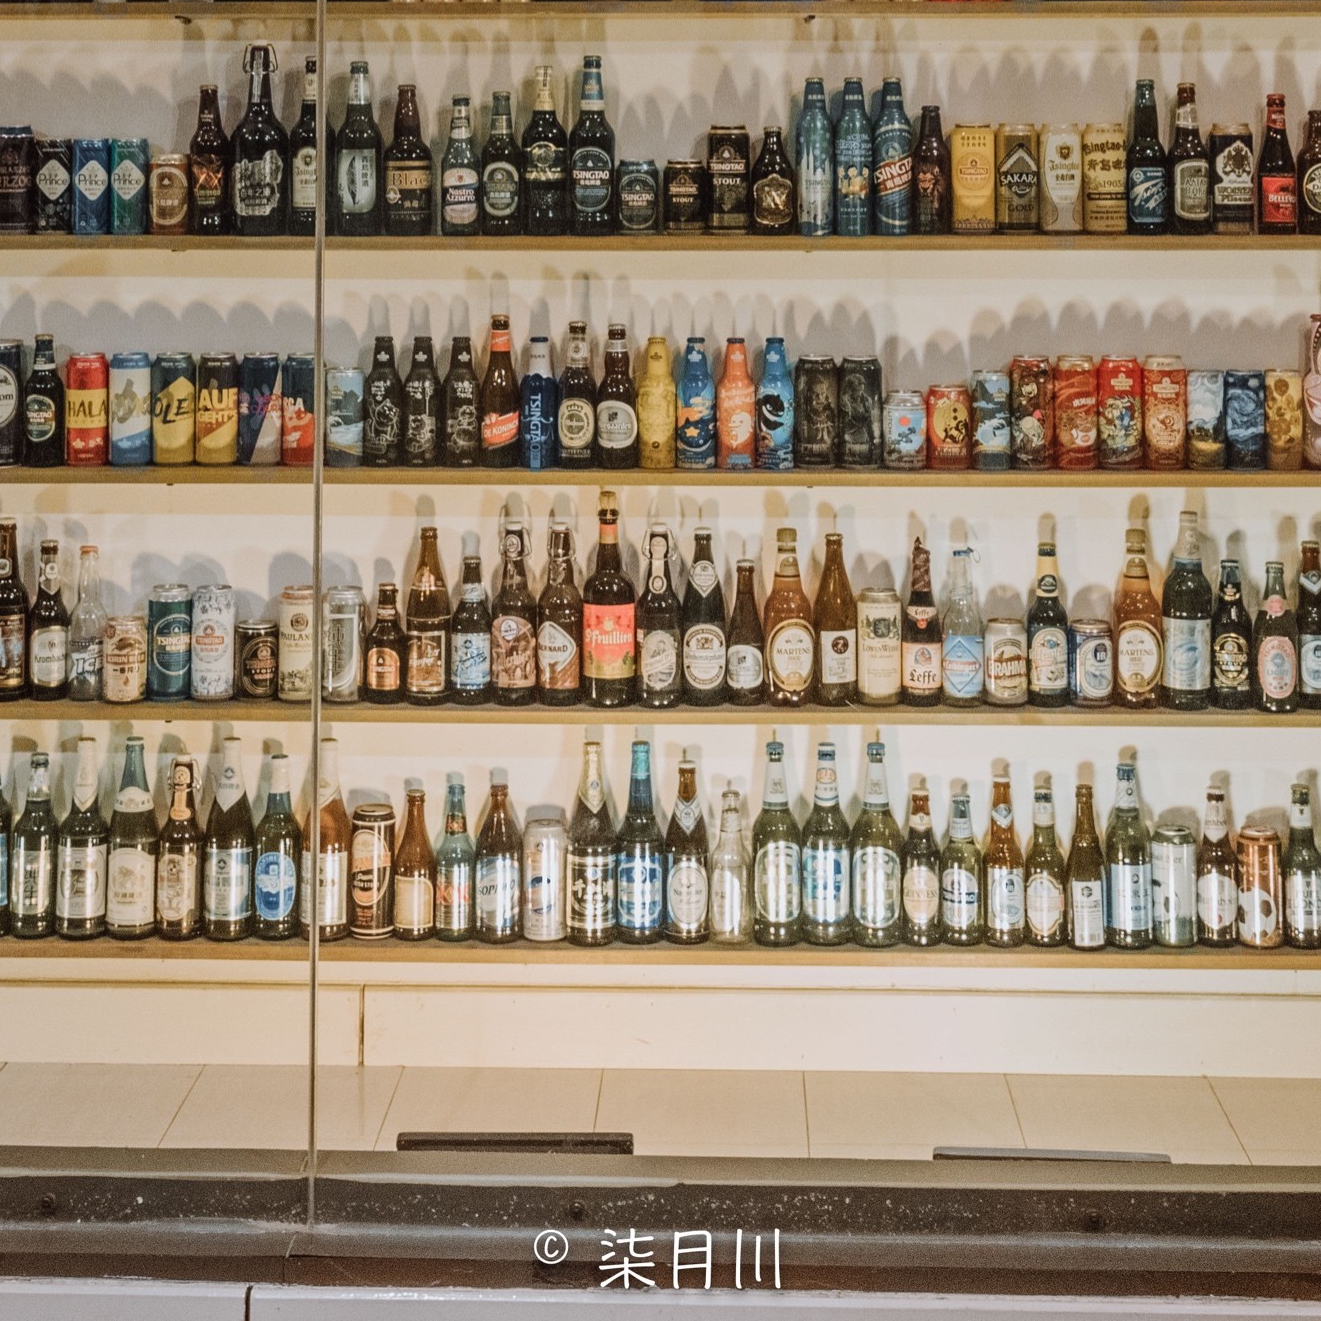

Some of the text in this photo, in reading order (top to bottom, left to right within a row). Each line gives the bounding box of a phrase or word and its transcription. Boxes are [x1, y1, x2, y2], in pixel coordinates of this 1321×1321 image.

[572, 170, 610, 179] TSINGTAO
[198, 388, 238, 409] AUF
[67, 399, 106, 417] HALA
[280, 632, 312, 641] PAULAN
